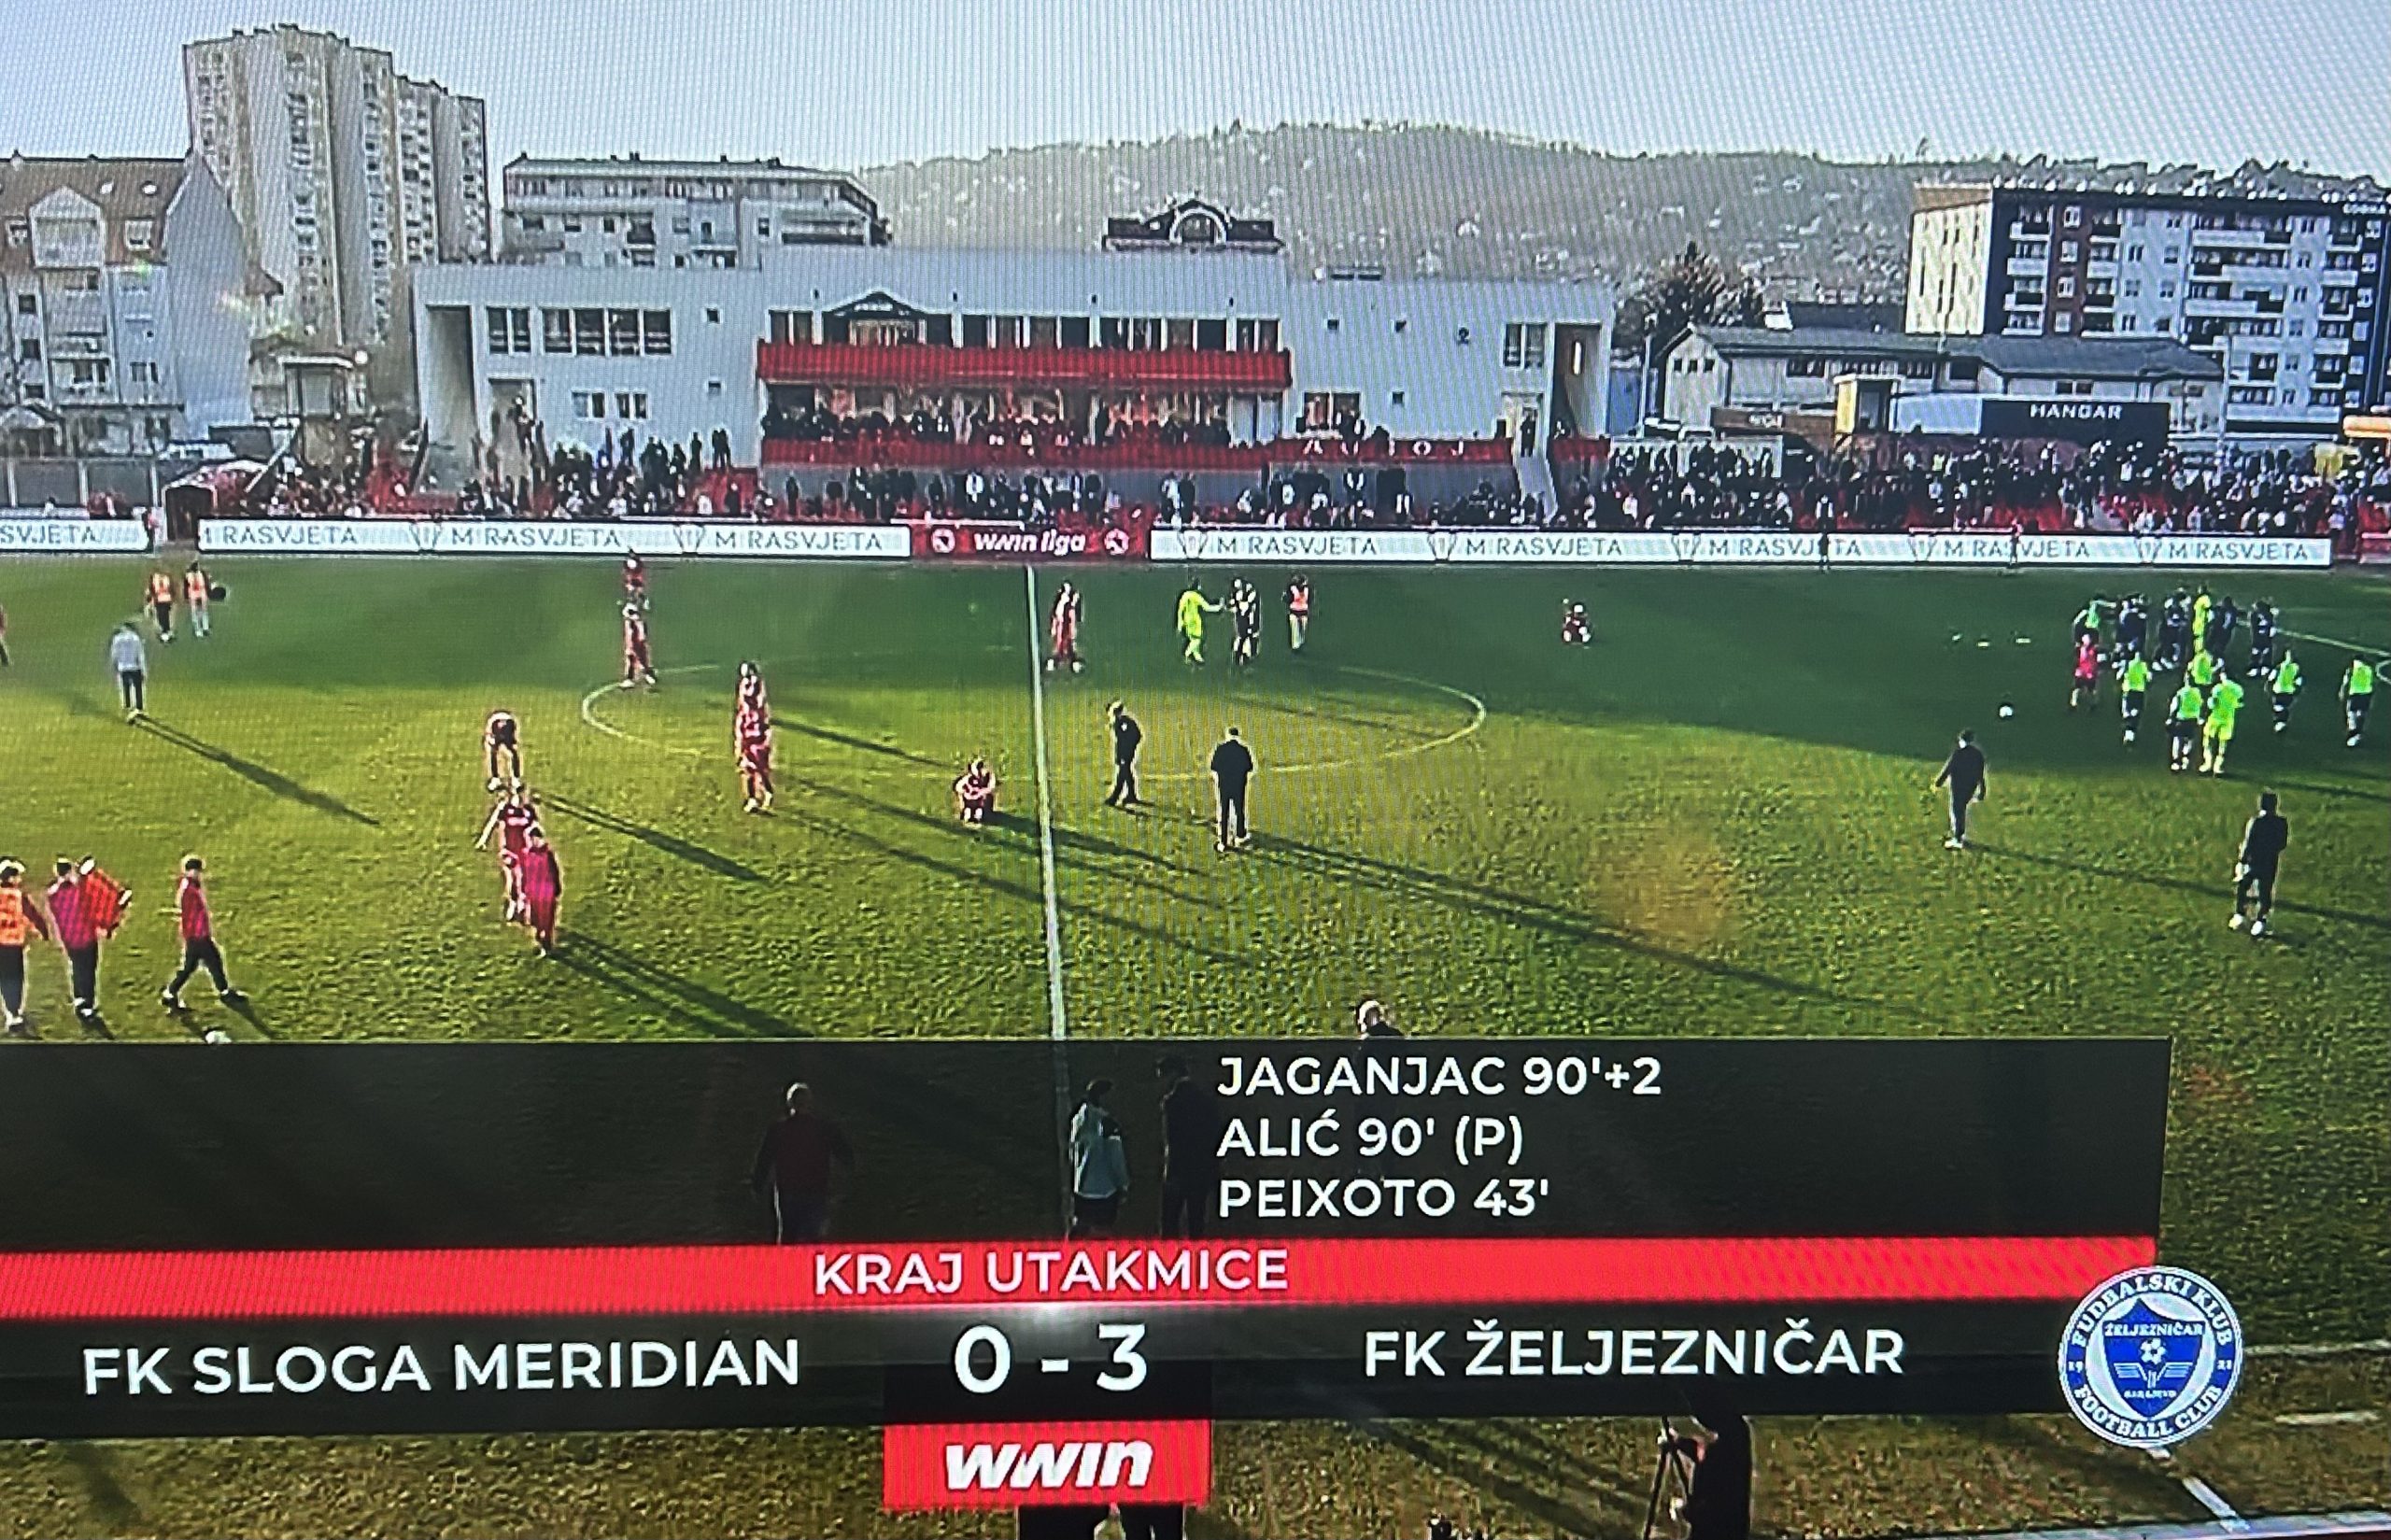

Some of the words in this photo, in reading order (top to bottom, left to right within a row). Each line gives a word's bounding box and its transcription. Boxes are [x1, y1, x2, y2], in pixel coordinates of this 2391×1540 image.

[2030, 403, 2123, 419] HANGAR
[223, 525, 358, 545] RASVJETA
[485, 527, 621, 547] RASVJETA
[747, 530, 884, 551] RASVJETA
[1040, 529, 1086, 557] liga
[1248, 535, 1377, 556] RASVJETA
[1496, 537, 1623, 557] RASVJETA
[1739, 537, 1862, 558] RASVJTA
[2196, 541, 2308, 560] RASVJETA
[1217, 1056, 1507, 1097] JAGANJAC
[1522, 1056, 1662, 1096] 90'+2
[1216, 1109, 1340, 1158] ALIĆ
[1357, 1118, 1436, 1157] 90'
[1454, 1115, 1523, 1166] (P)
[1218, 1179, 1457, 1218] PEIXOTO
[1472, 1178, 1550, 1216] 43'
[814, 1250, 964, 1295] KRAJ
[986, 1249, 1291, 1293] UTAKMICE
[2192, 1289, 2233, 1347] KLUB
[953, 1324, 1012, 1393] 0
[1096, 1322, 1148, 1392] 3
[1365, 1330, 1447, 1378] FK
[1464, 1318, 1906, 1377] ŽELJEZNIČAR
[83, 1348, 173, 1395] FK
[191, 1344, 432, 1394] SLOGA
[454, 1339, 800, 1391] MERIDIAN
[2073, 1384, 2175, 1439] FOOTBALL
[2174, 1384, 2224, 1429] CLUB
